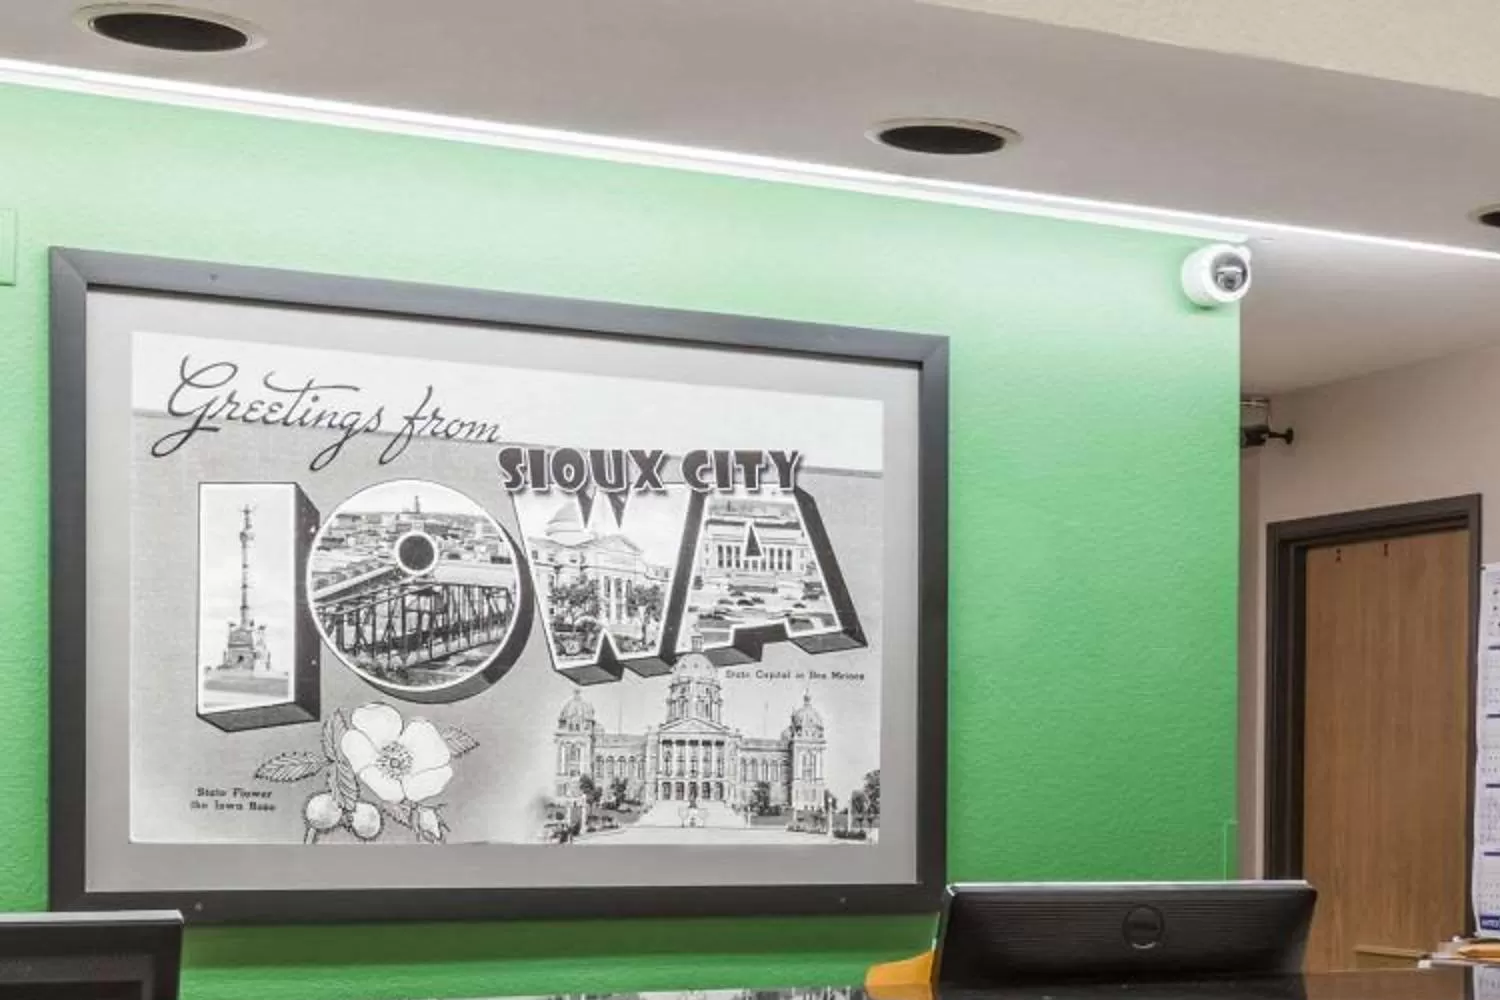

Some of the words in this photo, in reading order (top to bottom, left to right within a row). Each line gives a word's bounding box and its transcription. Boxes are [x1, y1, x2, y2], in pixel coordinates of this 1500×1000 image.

[378, 384, 503, 465] from
[498, 446, 664, 494] SIOUX
[680, 448, 801, 493] CITY
[197, 478, 869, 733] IOWA
